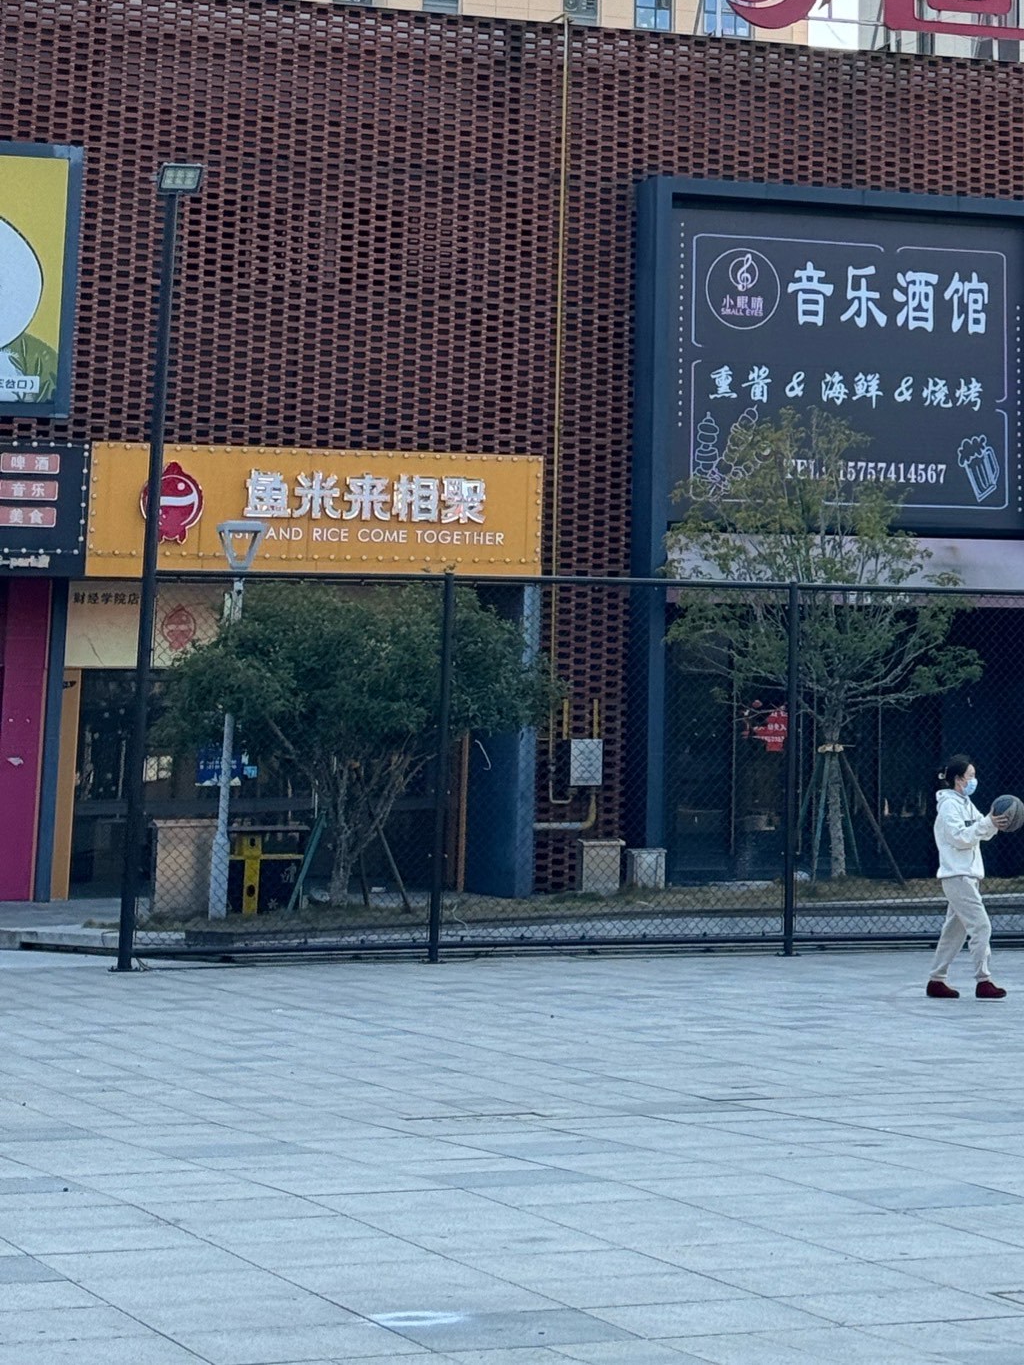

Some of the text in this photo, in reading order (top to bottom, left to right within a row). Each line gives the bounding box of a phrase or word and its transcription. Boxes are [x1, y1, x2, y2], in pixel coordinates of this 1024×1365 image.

[721, 294, 763, 310] 小眼睛
[787, 261, 989, 335] 音乐酒馆
[721, 307, 764, 317] SMALL EYES
[709, 365, 984, 412] 熏酱 & 海鲜 & 烧烤
[11, 455, 50, 471] 啤酒
[11, 482, 46, 498] 音乐
[243, 468, 487, 525] 鱼米来相聚
[9, 508, 44, 525] 美食
[265, 527, 303, 541] AND
[312, 527, 349, 542] RICE
[357, 528, 408, 543] COME
[415, 530, 505, 546] TOGETHER
[73, 591, 140, 606] 财经学院店
